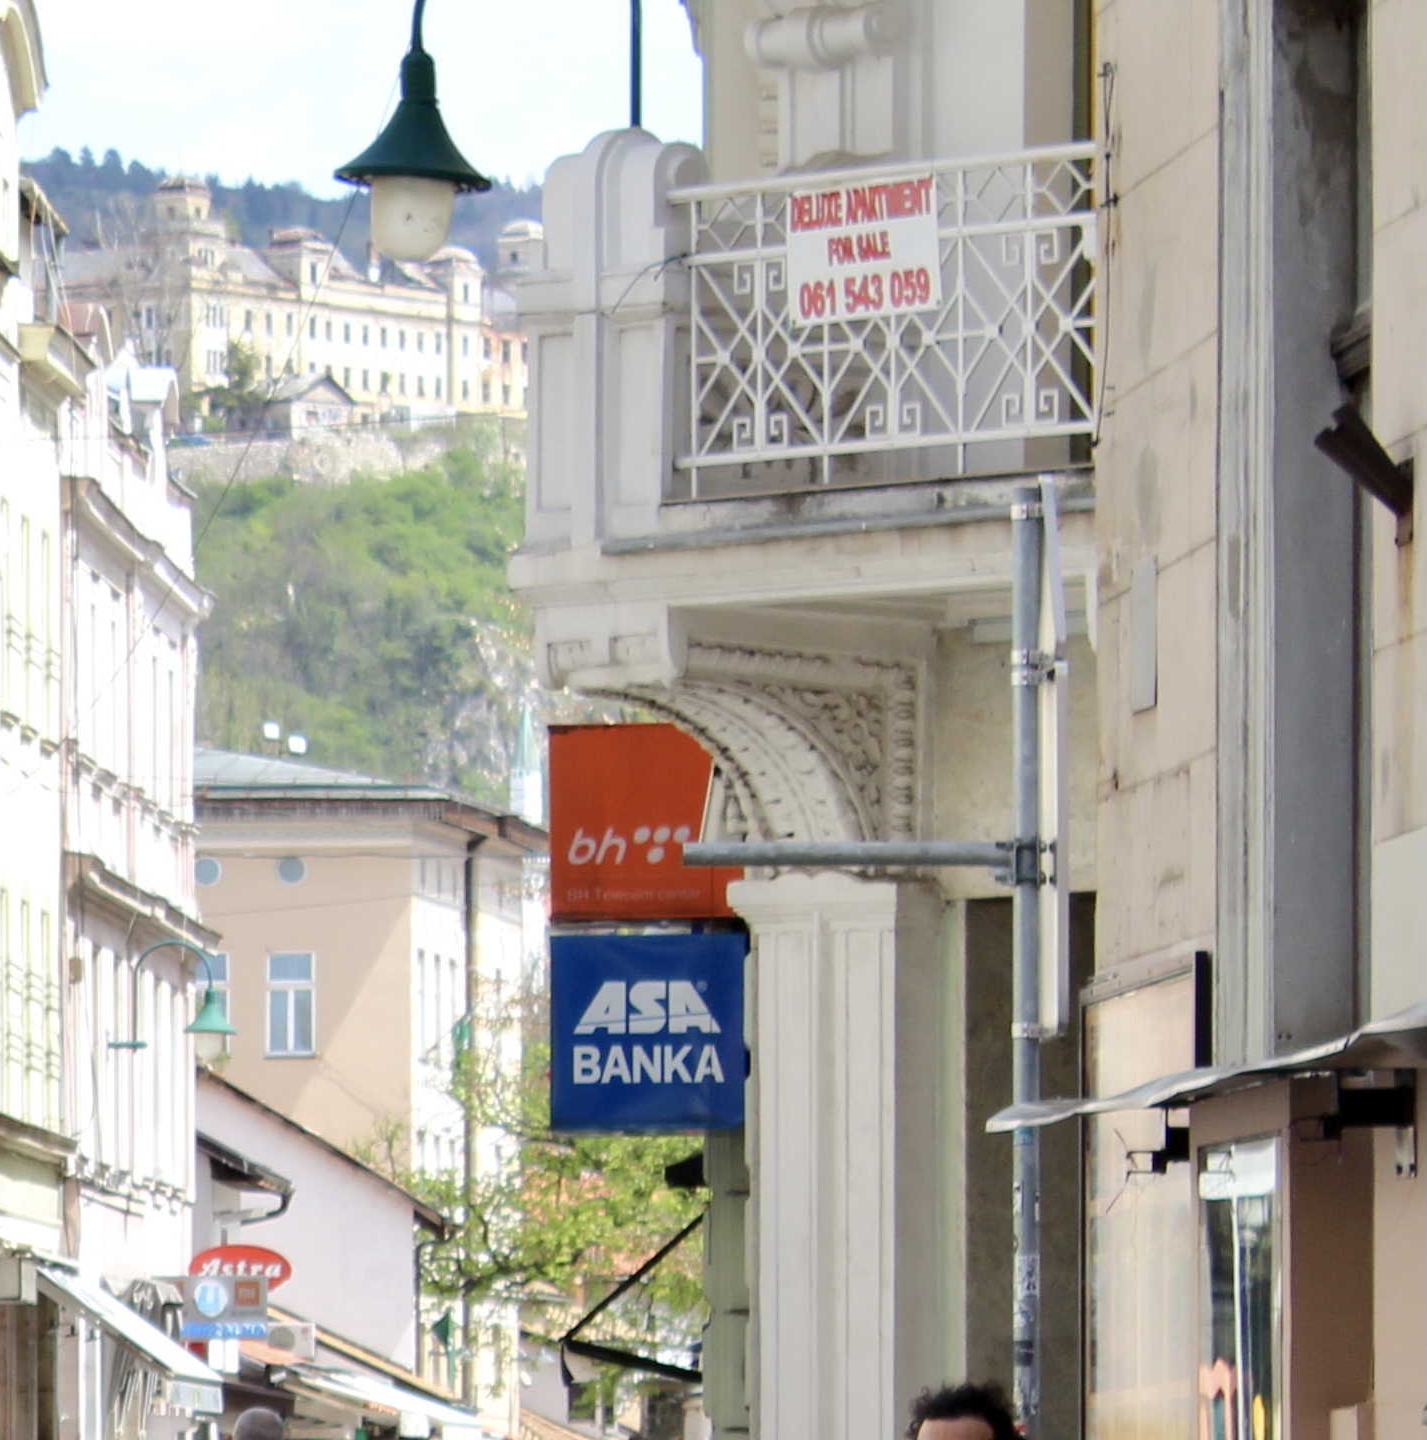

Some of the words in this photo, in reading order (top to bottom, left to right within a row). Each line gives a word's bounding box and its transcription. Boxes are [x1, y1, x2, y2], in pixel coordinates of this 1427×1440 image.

[791, 191, 843, 233] DELUXE
[846, 178, 932, 225] APARTMENT
[828, 235, 856, 266] FOR
[857, 230, 891, 263] SALE
[799, 279, 836, 319] 061
[844, 273, 883, 314] 543
[890, 267, 931, 308] 059
[567, 827, 627, 866] bh
[573, 980, 722, 1035] ASA
[573, 1044, 725, 1085] BANKA
[197, 1257, 283, 1279] Astra
